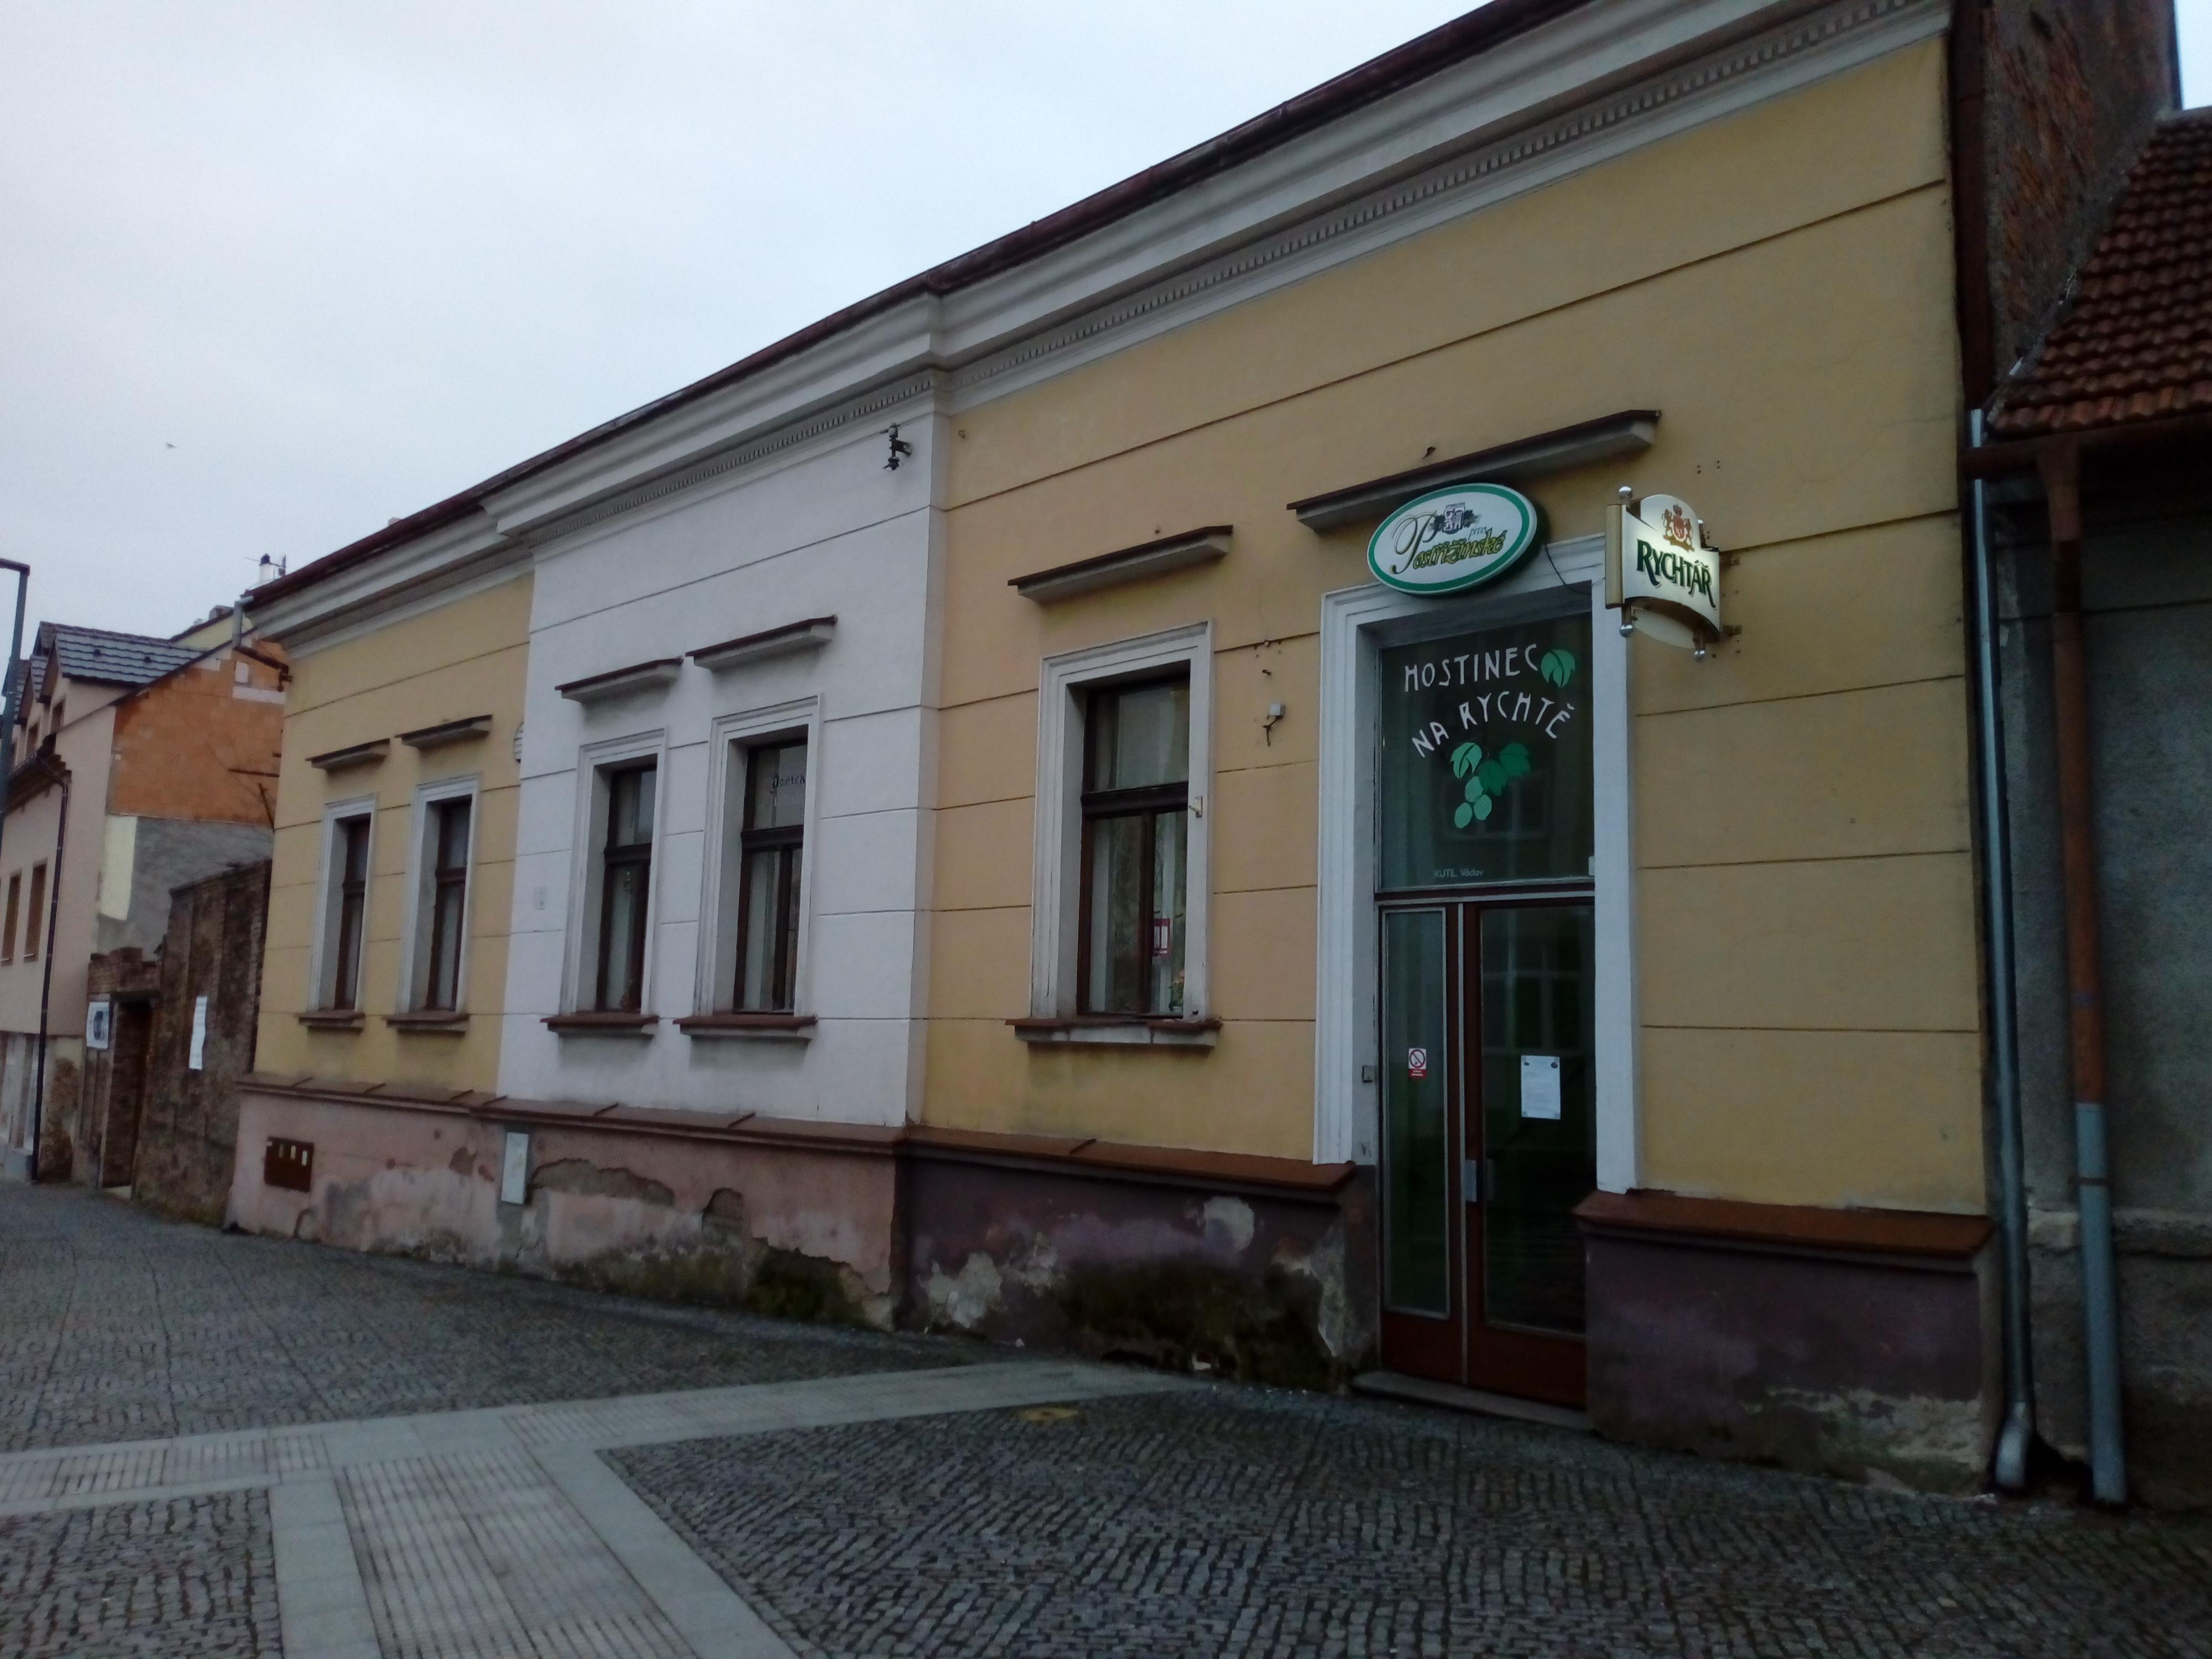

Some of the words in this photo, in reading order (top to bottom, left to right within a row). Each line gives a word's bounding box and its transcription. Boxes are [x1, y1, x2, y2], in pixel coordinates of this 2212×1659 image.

[1636, 539, 1717, 611] RYCHTÁŘ
[1404, 644, 1538, 692] HOSTINEC
[1411, 721, 1449, 758] NA
[1459, 691, 1575, 739] RYCHTĚ
